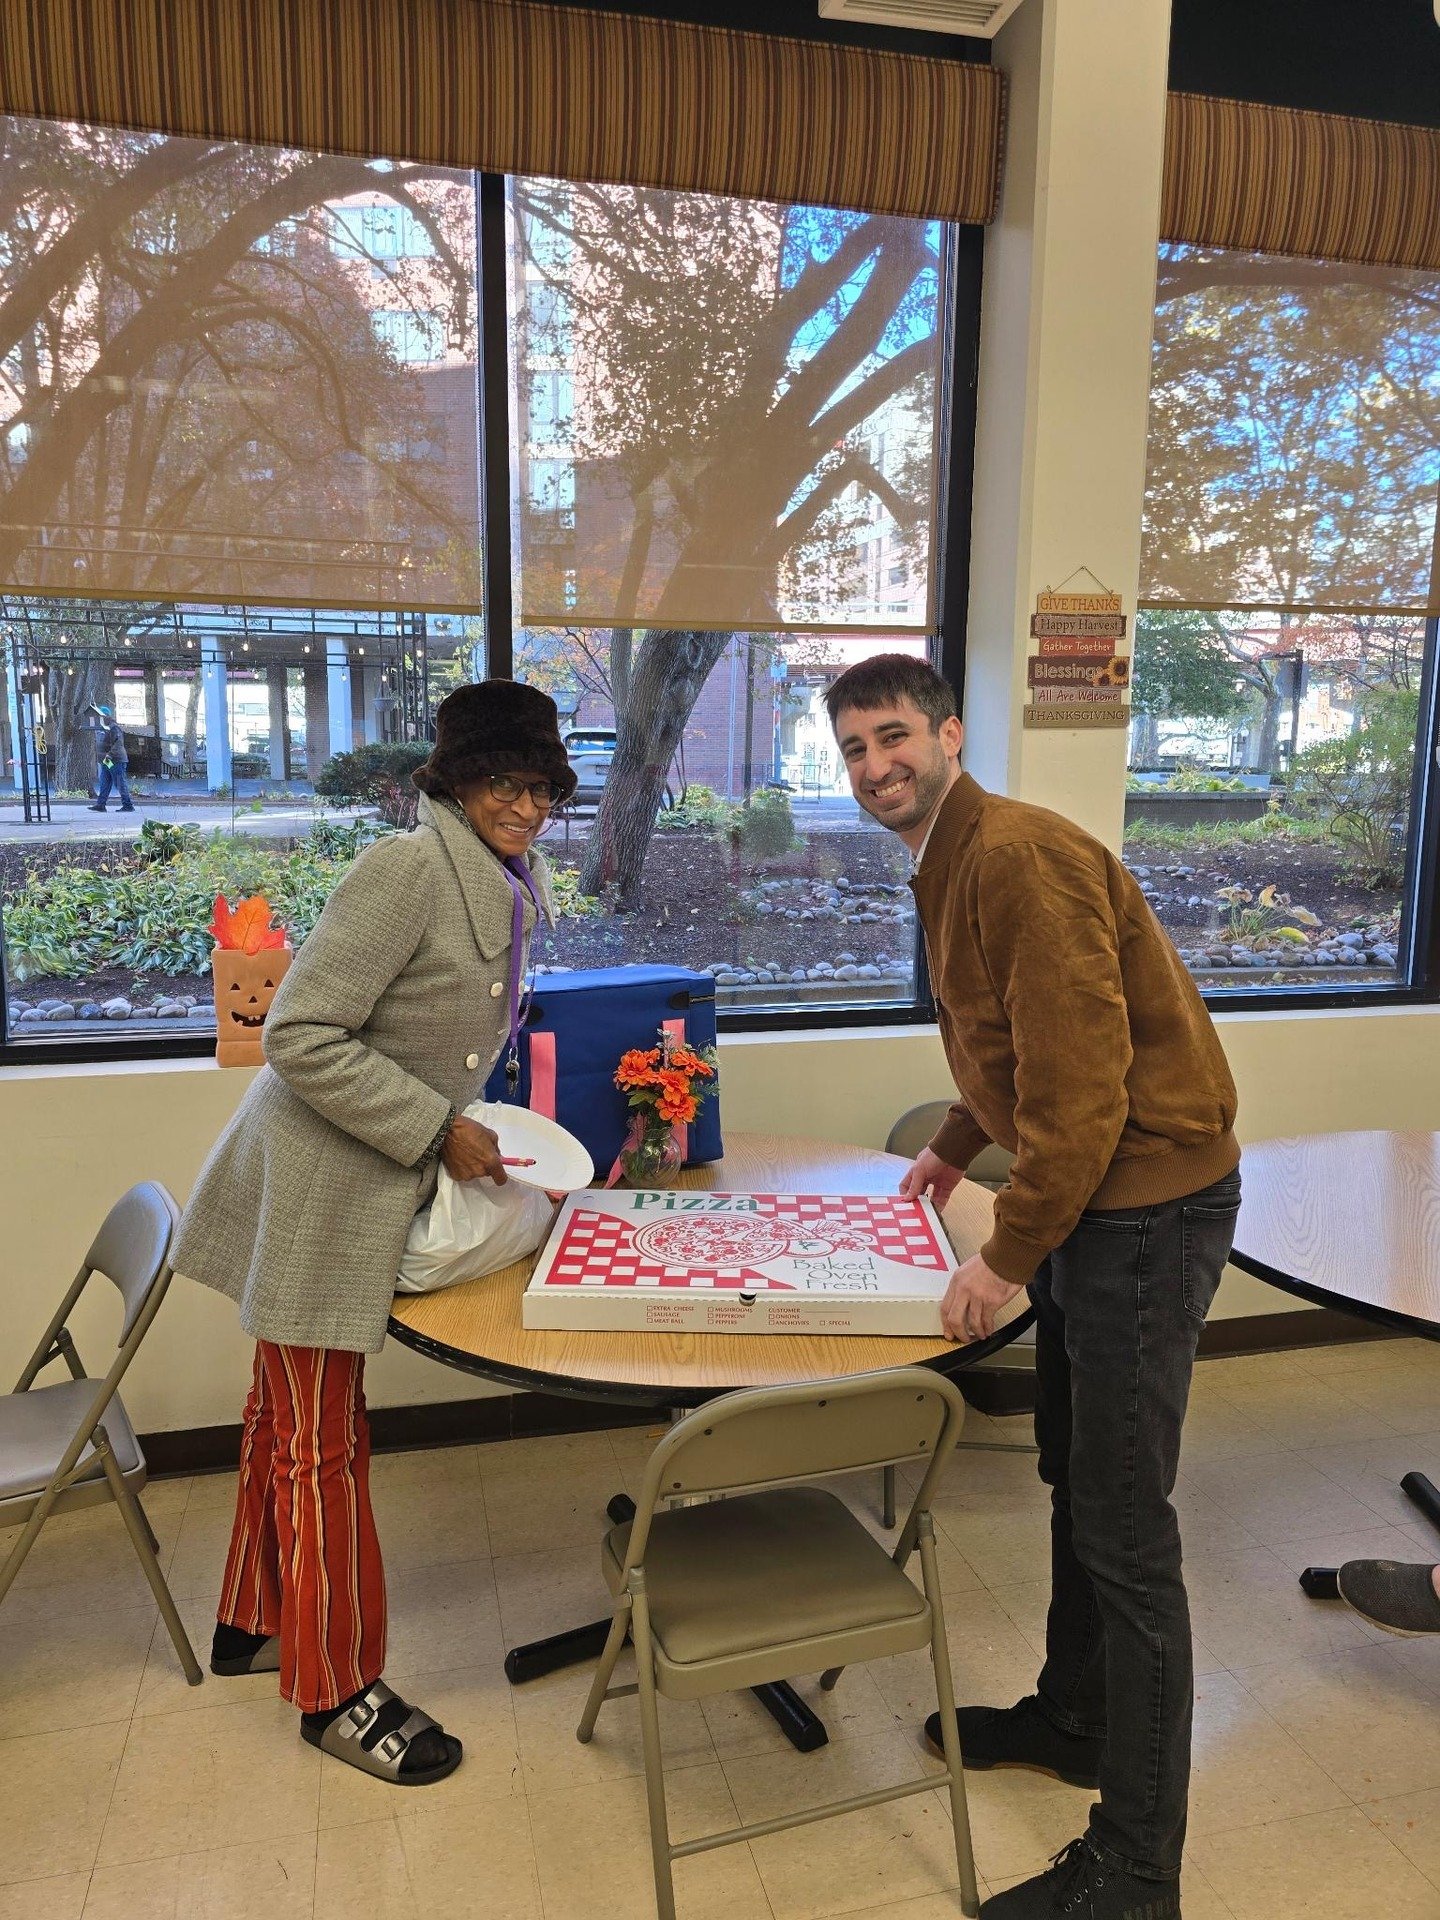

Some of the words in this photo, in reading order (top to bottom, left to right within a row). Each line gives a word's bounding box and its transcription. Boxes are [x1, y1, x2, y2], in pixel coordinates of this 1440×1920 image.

[1040, 598, 1069, 611] GIVE
[1073, 598, 1120, 611] THANKS
[1041, 618, 1076, 634] Happy
[1078, 619, 1119, 631] Harvest
[1043, 640, 1073, 652] Gather
[1075, 641, 1112, 653] Together
[1038, 690, 1051, 702] All
[1056, 690, 1075, 702] Are
[1078, 690, 1118, 702] Welcome
[1028, 709, 1125, 721] THANKSGIVING
[629, 1192, 760, 1211] Pizza
[793, 1256, 875, 1270] Baked
[808, 1269, 878, 1280] Oven
[805, 1277, 878, 1291] Fresh
